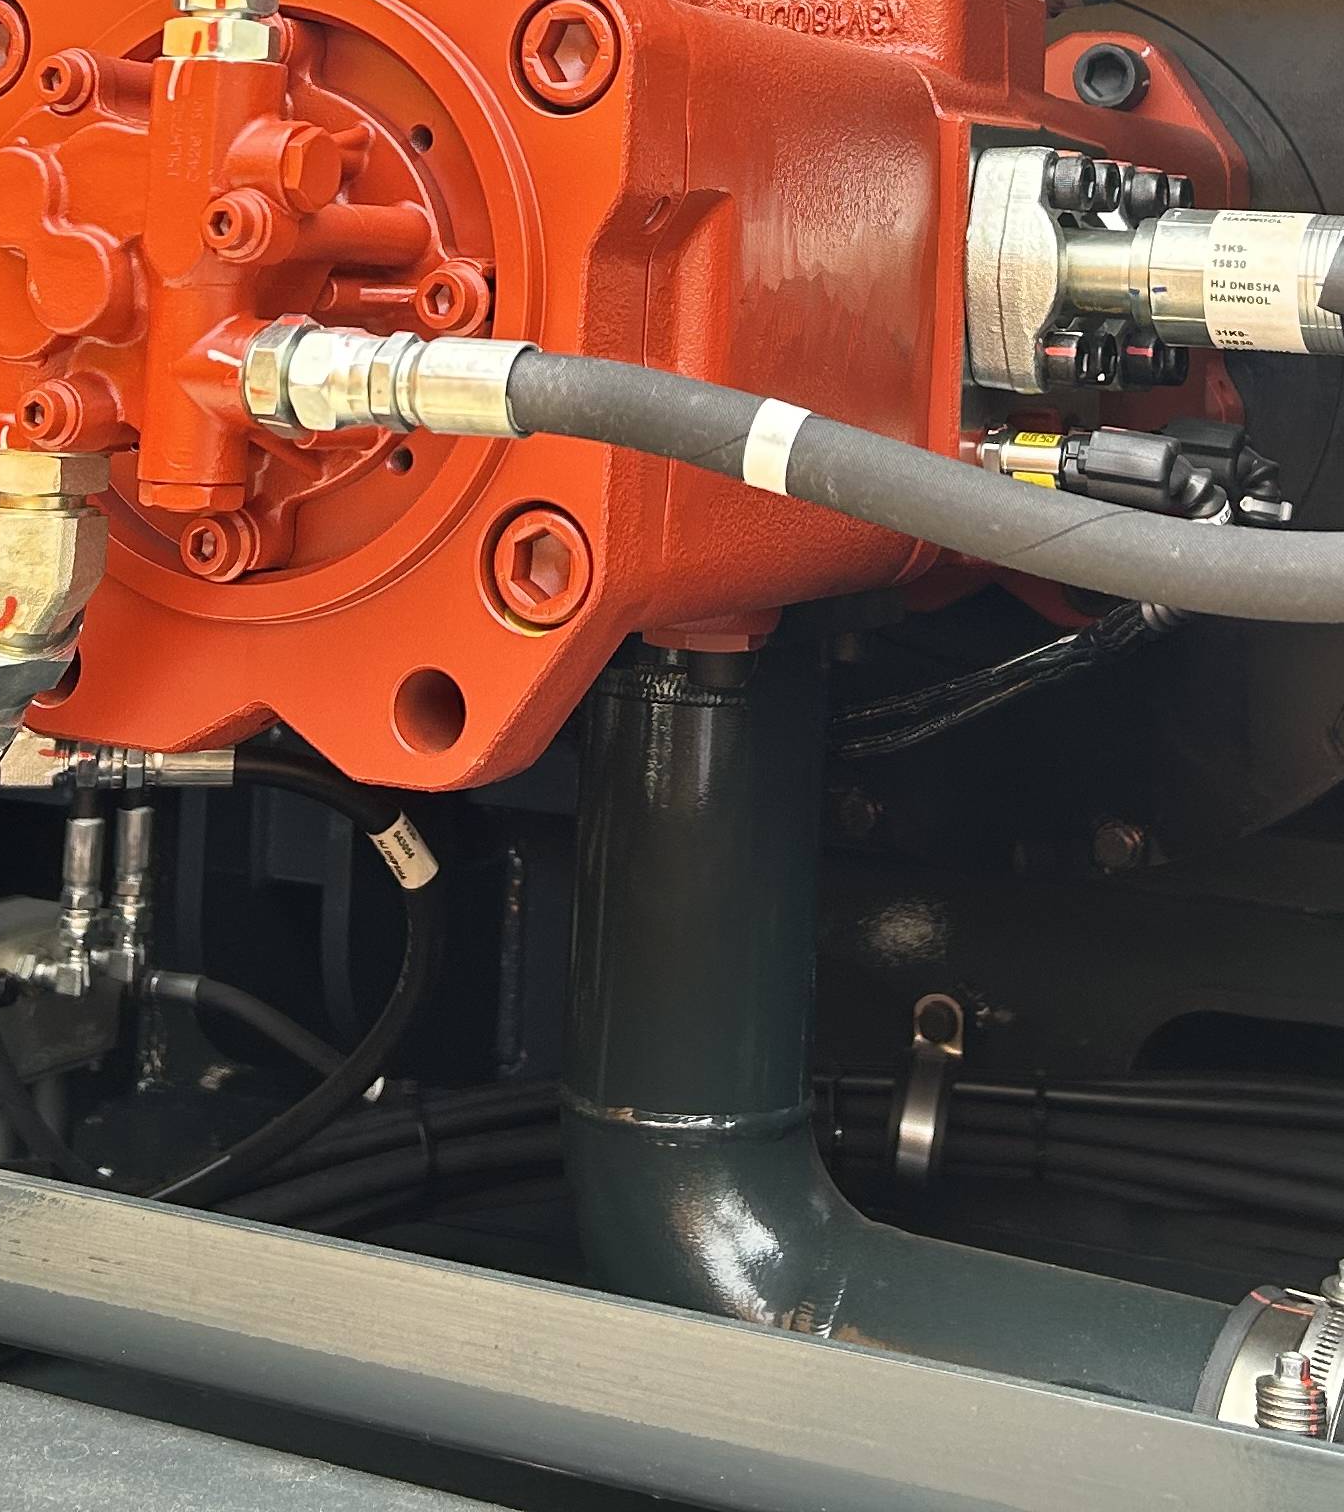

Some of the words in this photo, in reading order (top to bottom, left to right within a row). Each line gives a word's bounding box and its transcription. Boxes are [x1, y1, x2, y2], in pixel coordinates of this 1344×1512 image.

[1211, 259, 1247, 269] 15830
[1210, 280, 1226, 289] HJ
[1210, 294, 1272, 305] HANWOOL
